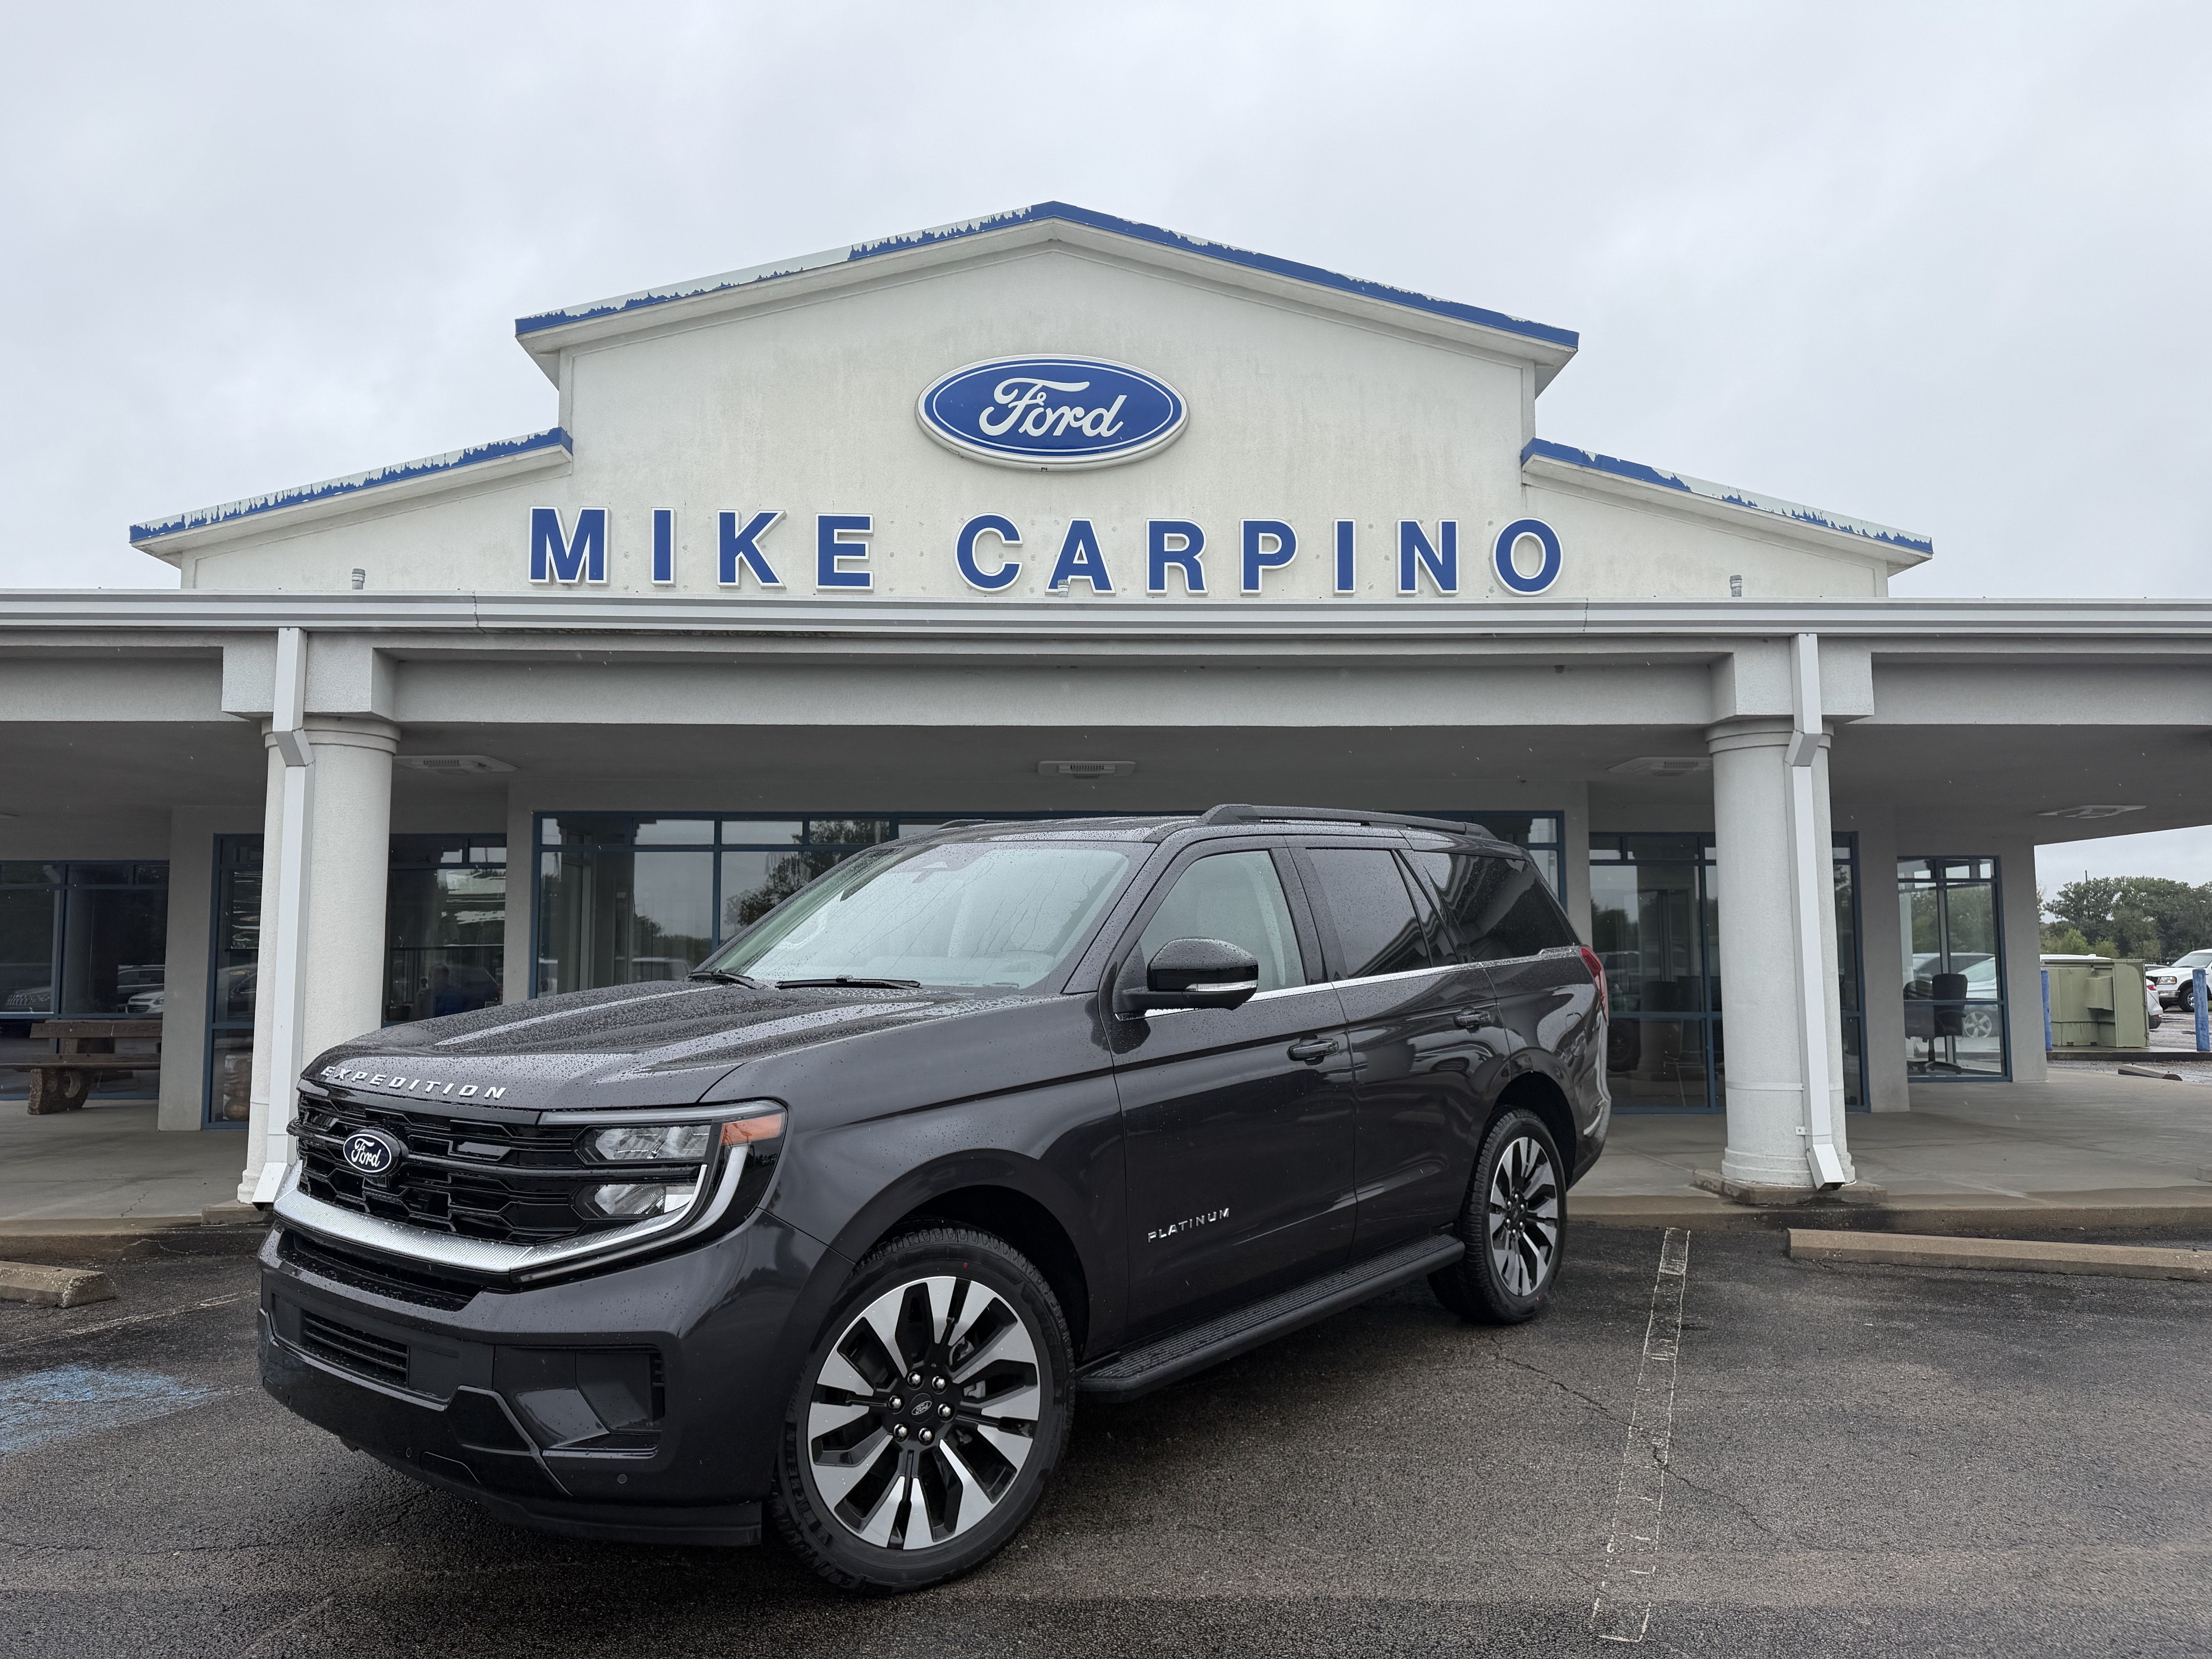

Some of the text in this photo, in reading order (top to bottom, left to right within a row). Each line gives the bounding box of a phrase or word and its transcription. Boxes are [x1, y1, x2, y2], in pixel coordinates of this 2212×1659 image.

[979, 377, 1127, 437] Ford
[528, 506, 1563, 596] MIKE CARPINO
[321, 1066, 507, 1099] EXPEDITION
[351, 1138, 381, 1168] Ford
[1148, 1208, 1229, 1243] PLATINUM
[915, 1402, 929, 1413] Ford
[786, 1431, 818, 1524] MICHELIN
